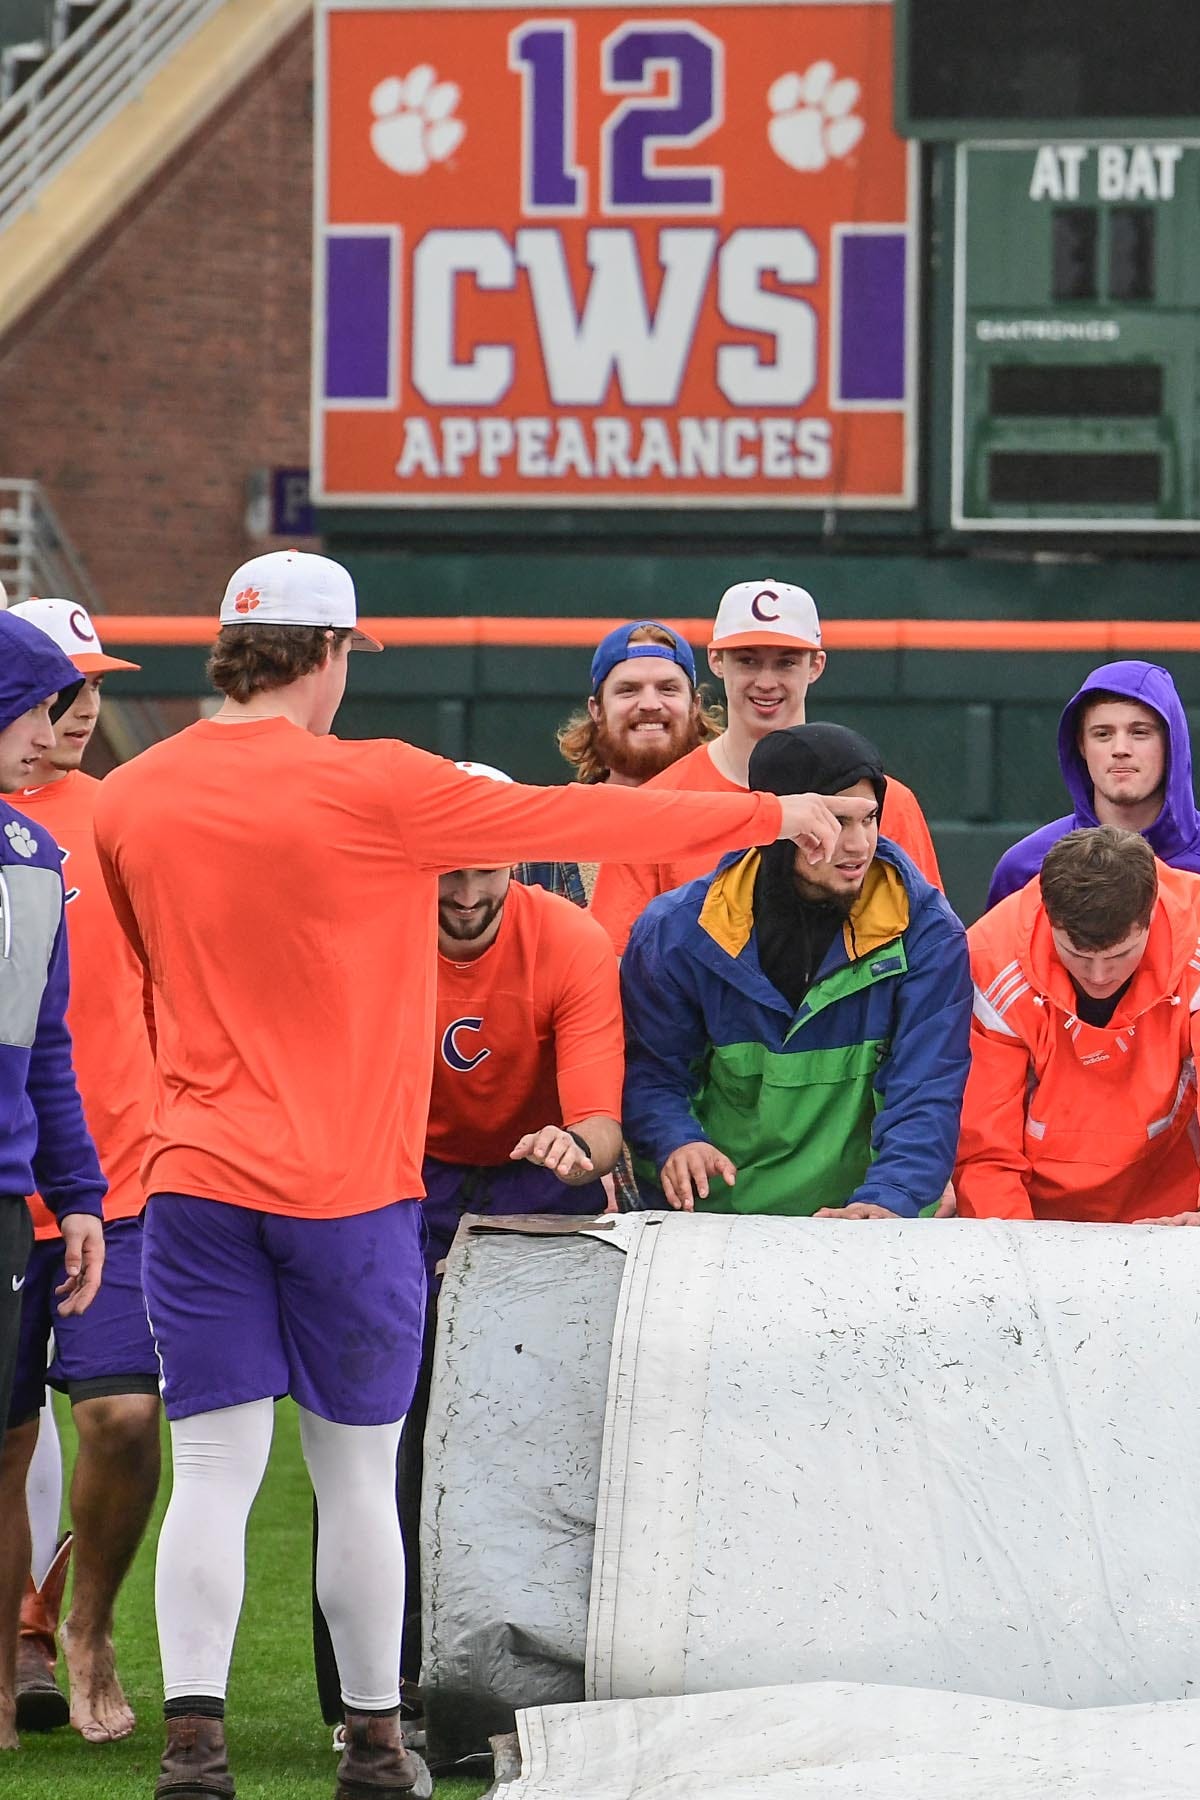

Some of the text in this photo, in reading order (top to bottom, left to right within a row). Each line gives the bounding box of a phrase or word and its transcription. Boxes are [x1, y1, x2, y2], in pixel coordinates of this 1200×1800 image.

[509, 20, 724, 217] 12
[1030, 147, 1183, 200] AT BAT
[413, 228, 817, 407] CWS
[397, 417, 831, 478] APPEARANCES
[69, 609, 94, 642] C
[752, 590, 781, 622] C
[441, 1016, 492, 1072] C
